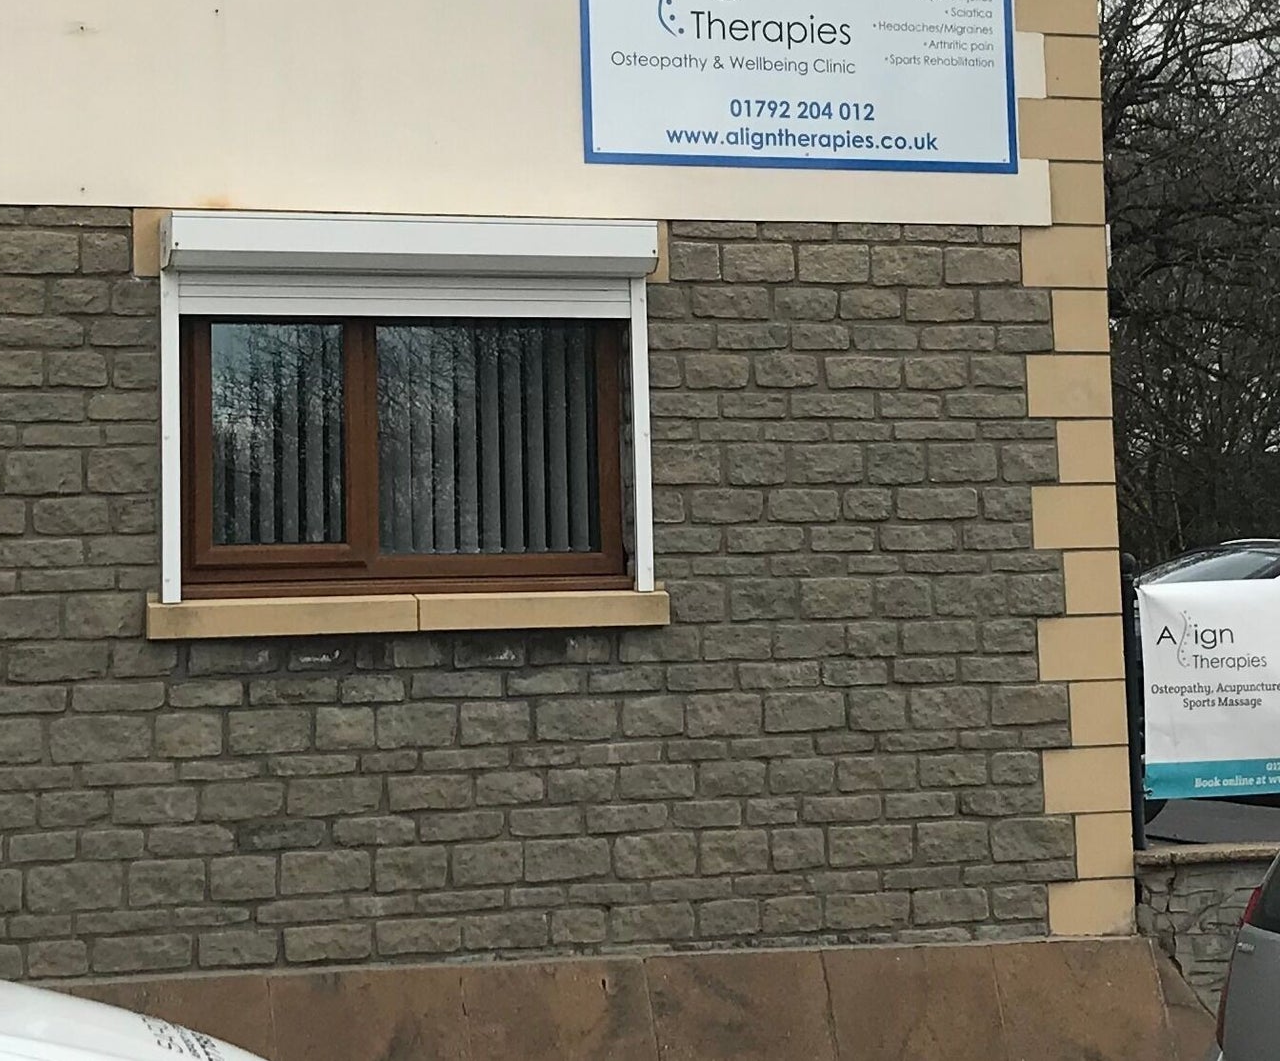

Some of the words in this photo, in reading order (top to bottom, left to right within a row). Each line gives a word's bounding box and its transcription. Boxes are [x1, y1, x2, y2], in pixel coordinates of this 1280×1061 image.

[950, 7, 993, 19] Sciatica
[690, 10, 852, 50] Therapies
[878, 21, 994, 36] Headaches/Migraines
[928, 40, 968, 52] Arthritic
[970, 42, 995, 53] pain
[611, 50, 708, 72] Osteopathy
[712, 55, 725, 69] &
[730, 55, 809, 76] Wellbeing
[813, 58, 857, 74] Clinic
[889, 53, 921, 66] Sports
[923, 54, 995, 69] Rehabilitation
[729, 98, 791, 119] 01792
[796, 100, 833, 120] 204
[838, 101, 876, 121] 012
[665, 127, 939, 152] www.aligntherapies.co.uk
[1192, 653, 1268, 671] Therapies
[1150, 682, 1215, 697] Osteopathy,
[1182, 697, 1216, 710] Sports
[1217, 696, 1263, 709] Massage
[1194, 777, 1221, 789] Book
[1222, 774, 1254, 788] online
[1255, 775, 1266, 786] at
